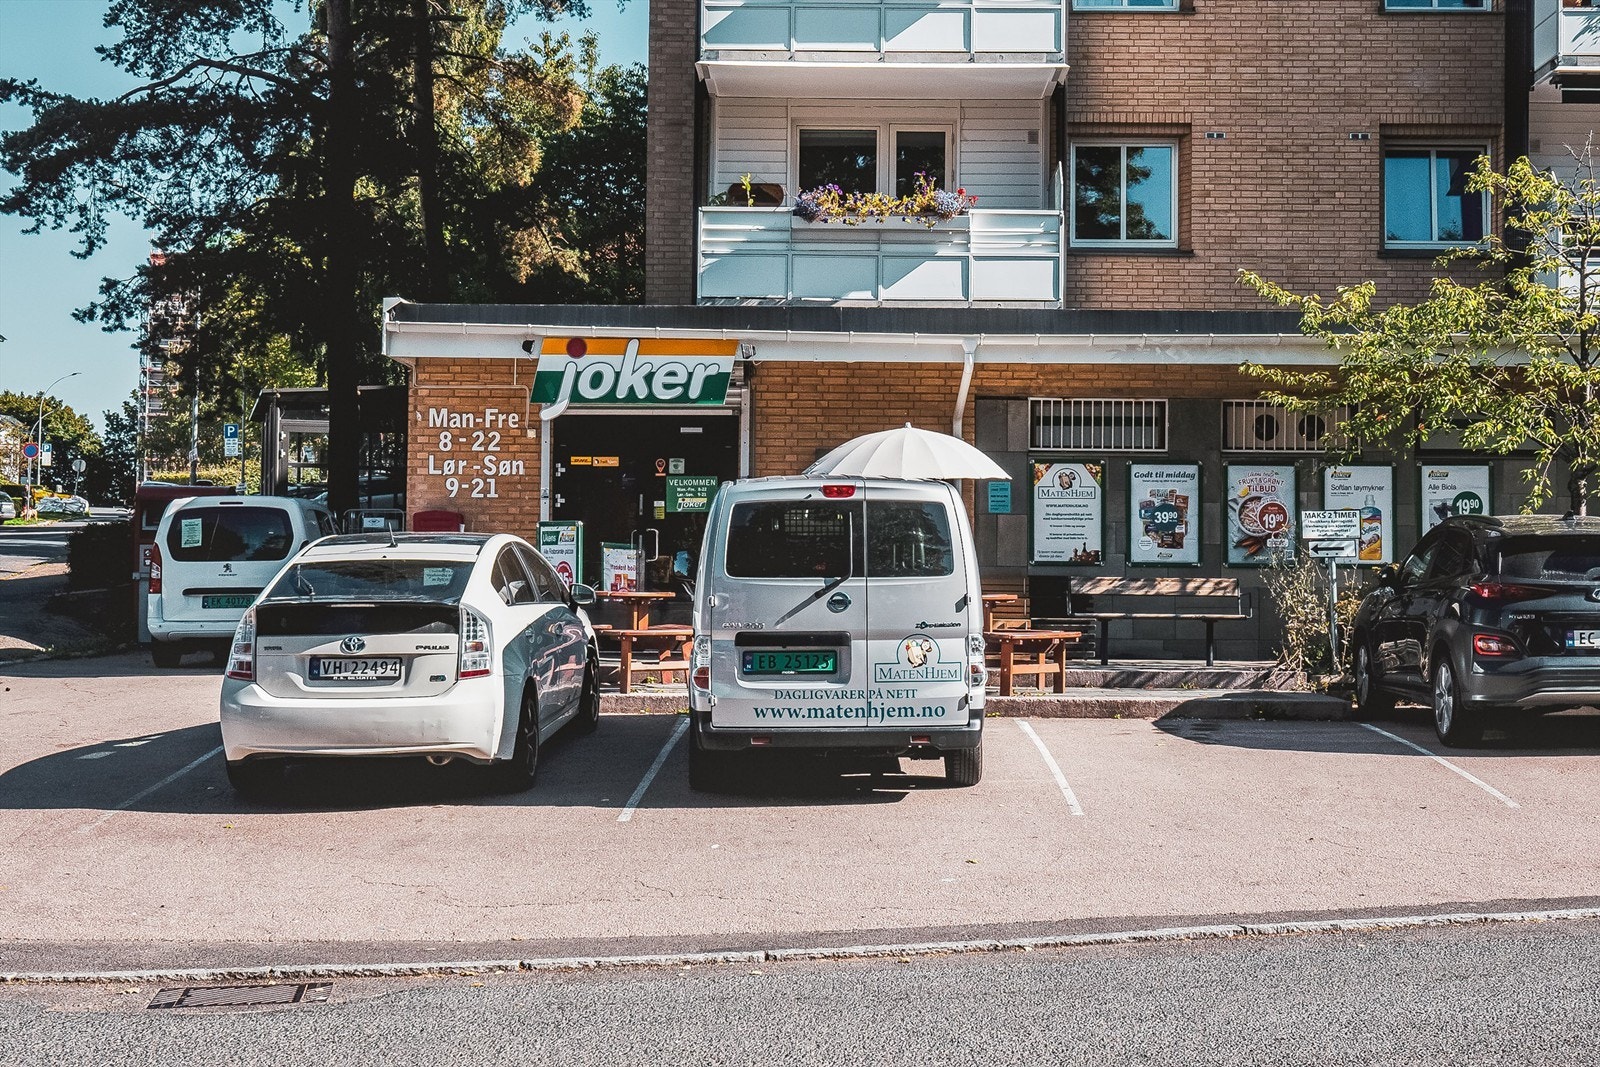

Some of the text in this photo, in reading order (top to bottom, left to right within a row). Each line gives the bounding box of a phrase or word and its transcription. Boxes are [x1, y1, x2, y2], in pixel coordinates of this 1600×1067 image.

[540, 337, 720, 420] joker
[428, 407, 519, 428] Man-Fre
[227, 426, 235, 436] P
[1134, 471, 1153, 479] Godt
[1165, 471, 1196, 480] middag
[1354, 484, 1385, 492] tøymykner
[677, 498, 705, 512] joker
[1580, 632, 1595, 645] EC
[322, 661, 398, 675] VH 22494
[758, 655, 829, 669] EB 25125
[774, 687, 918, 700] DAGLIGVARER PÅ NETT
[753, 701, 946, 723] www.matenhjem.no
